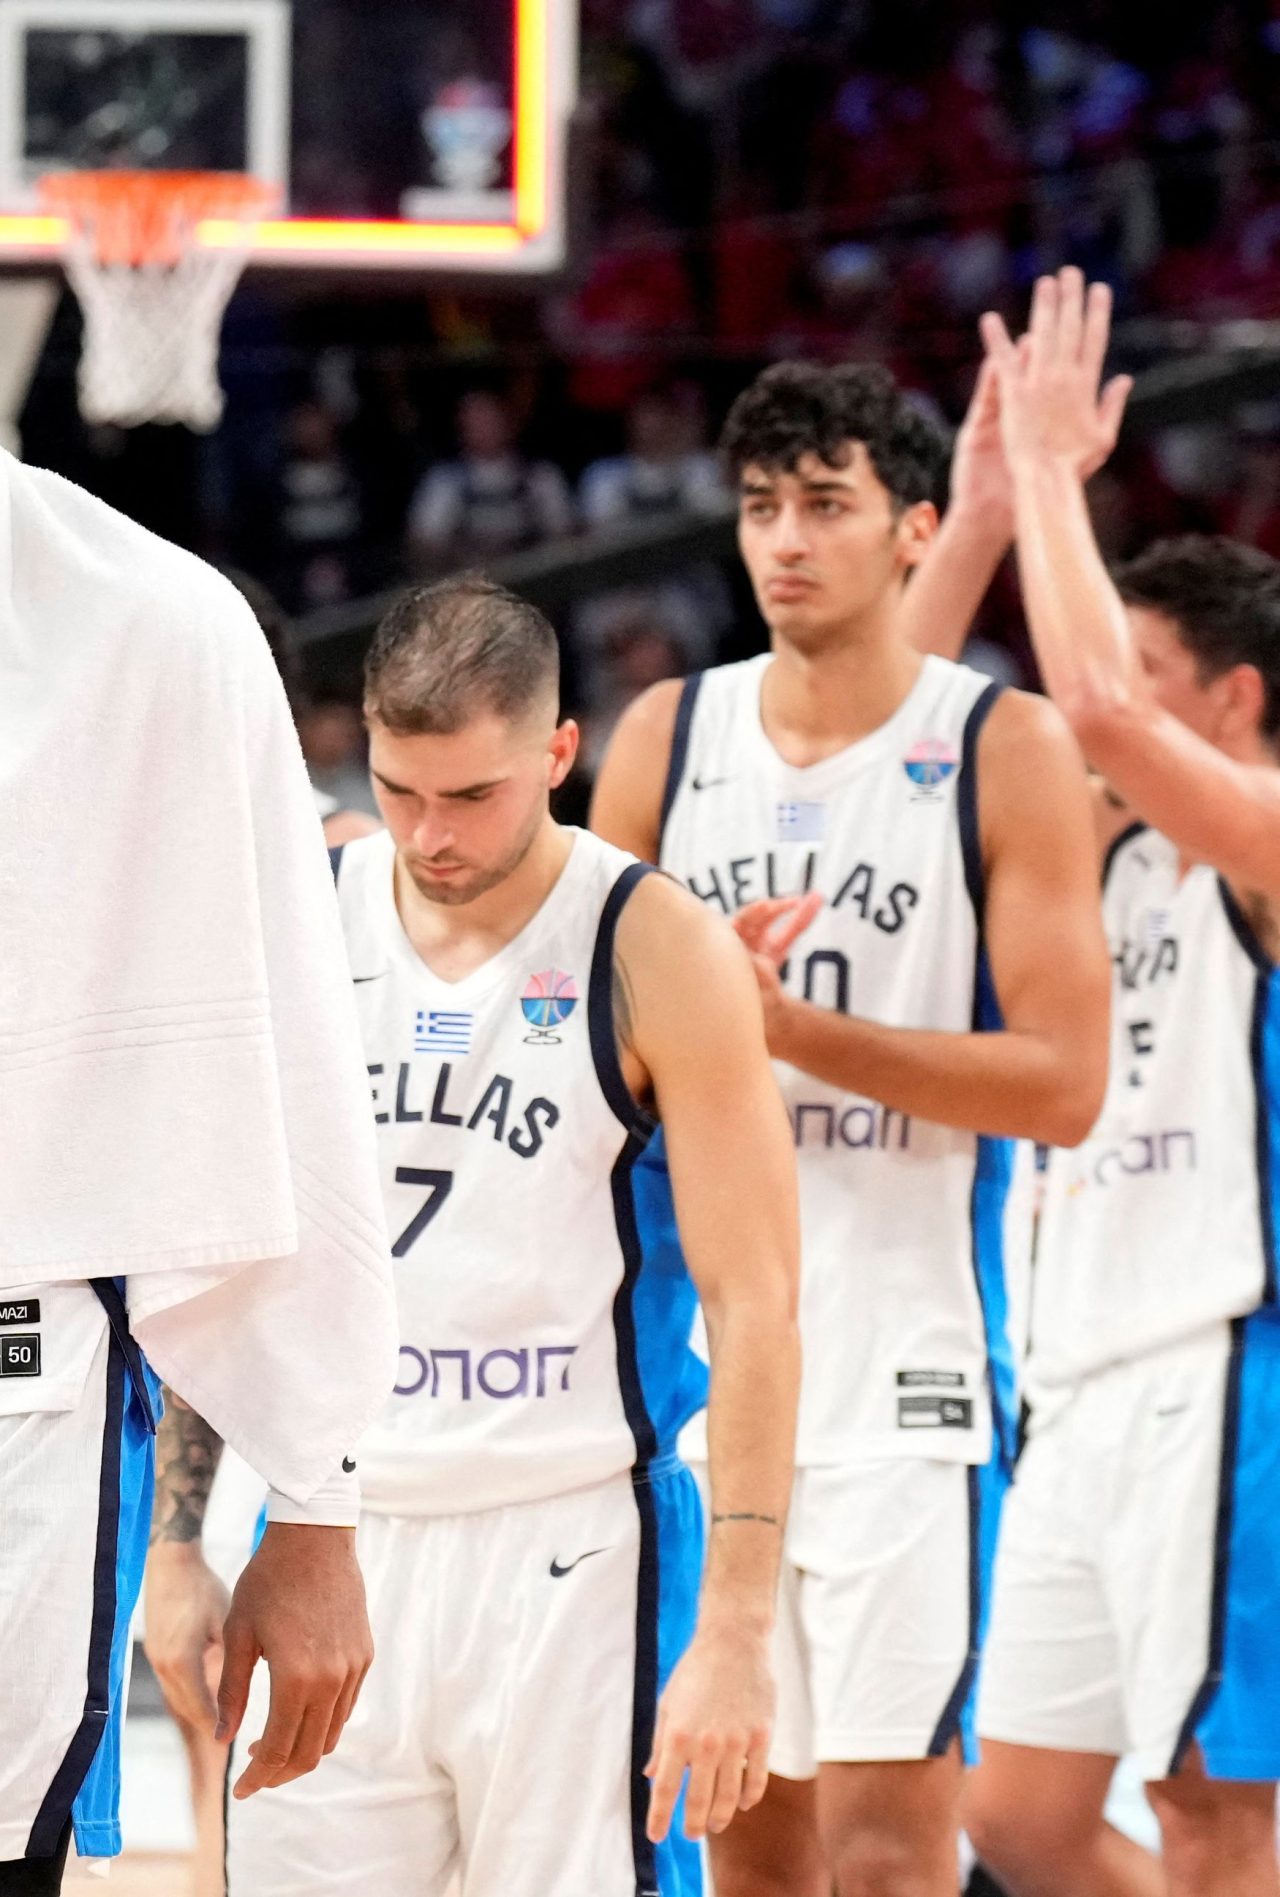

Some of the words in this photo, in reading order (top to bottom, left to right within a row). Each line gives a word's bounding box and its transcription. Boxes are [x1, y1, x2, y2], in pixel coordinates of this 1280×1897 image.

[779, 951, 849, 1014] 0
[367, 1062, 560, 1159] ELLAS
[391, 1167, 454, 1258] 7
[8, 1346, 31, 1363] 50
